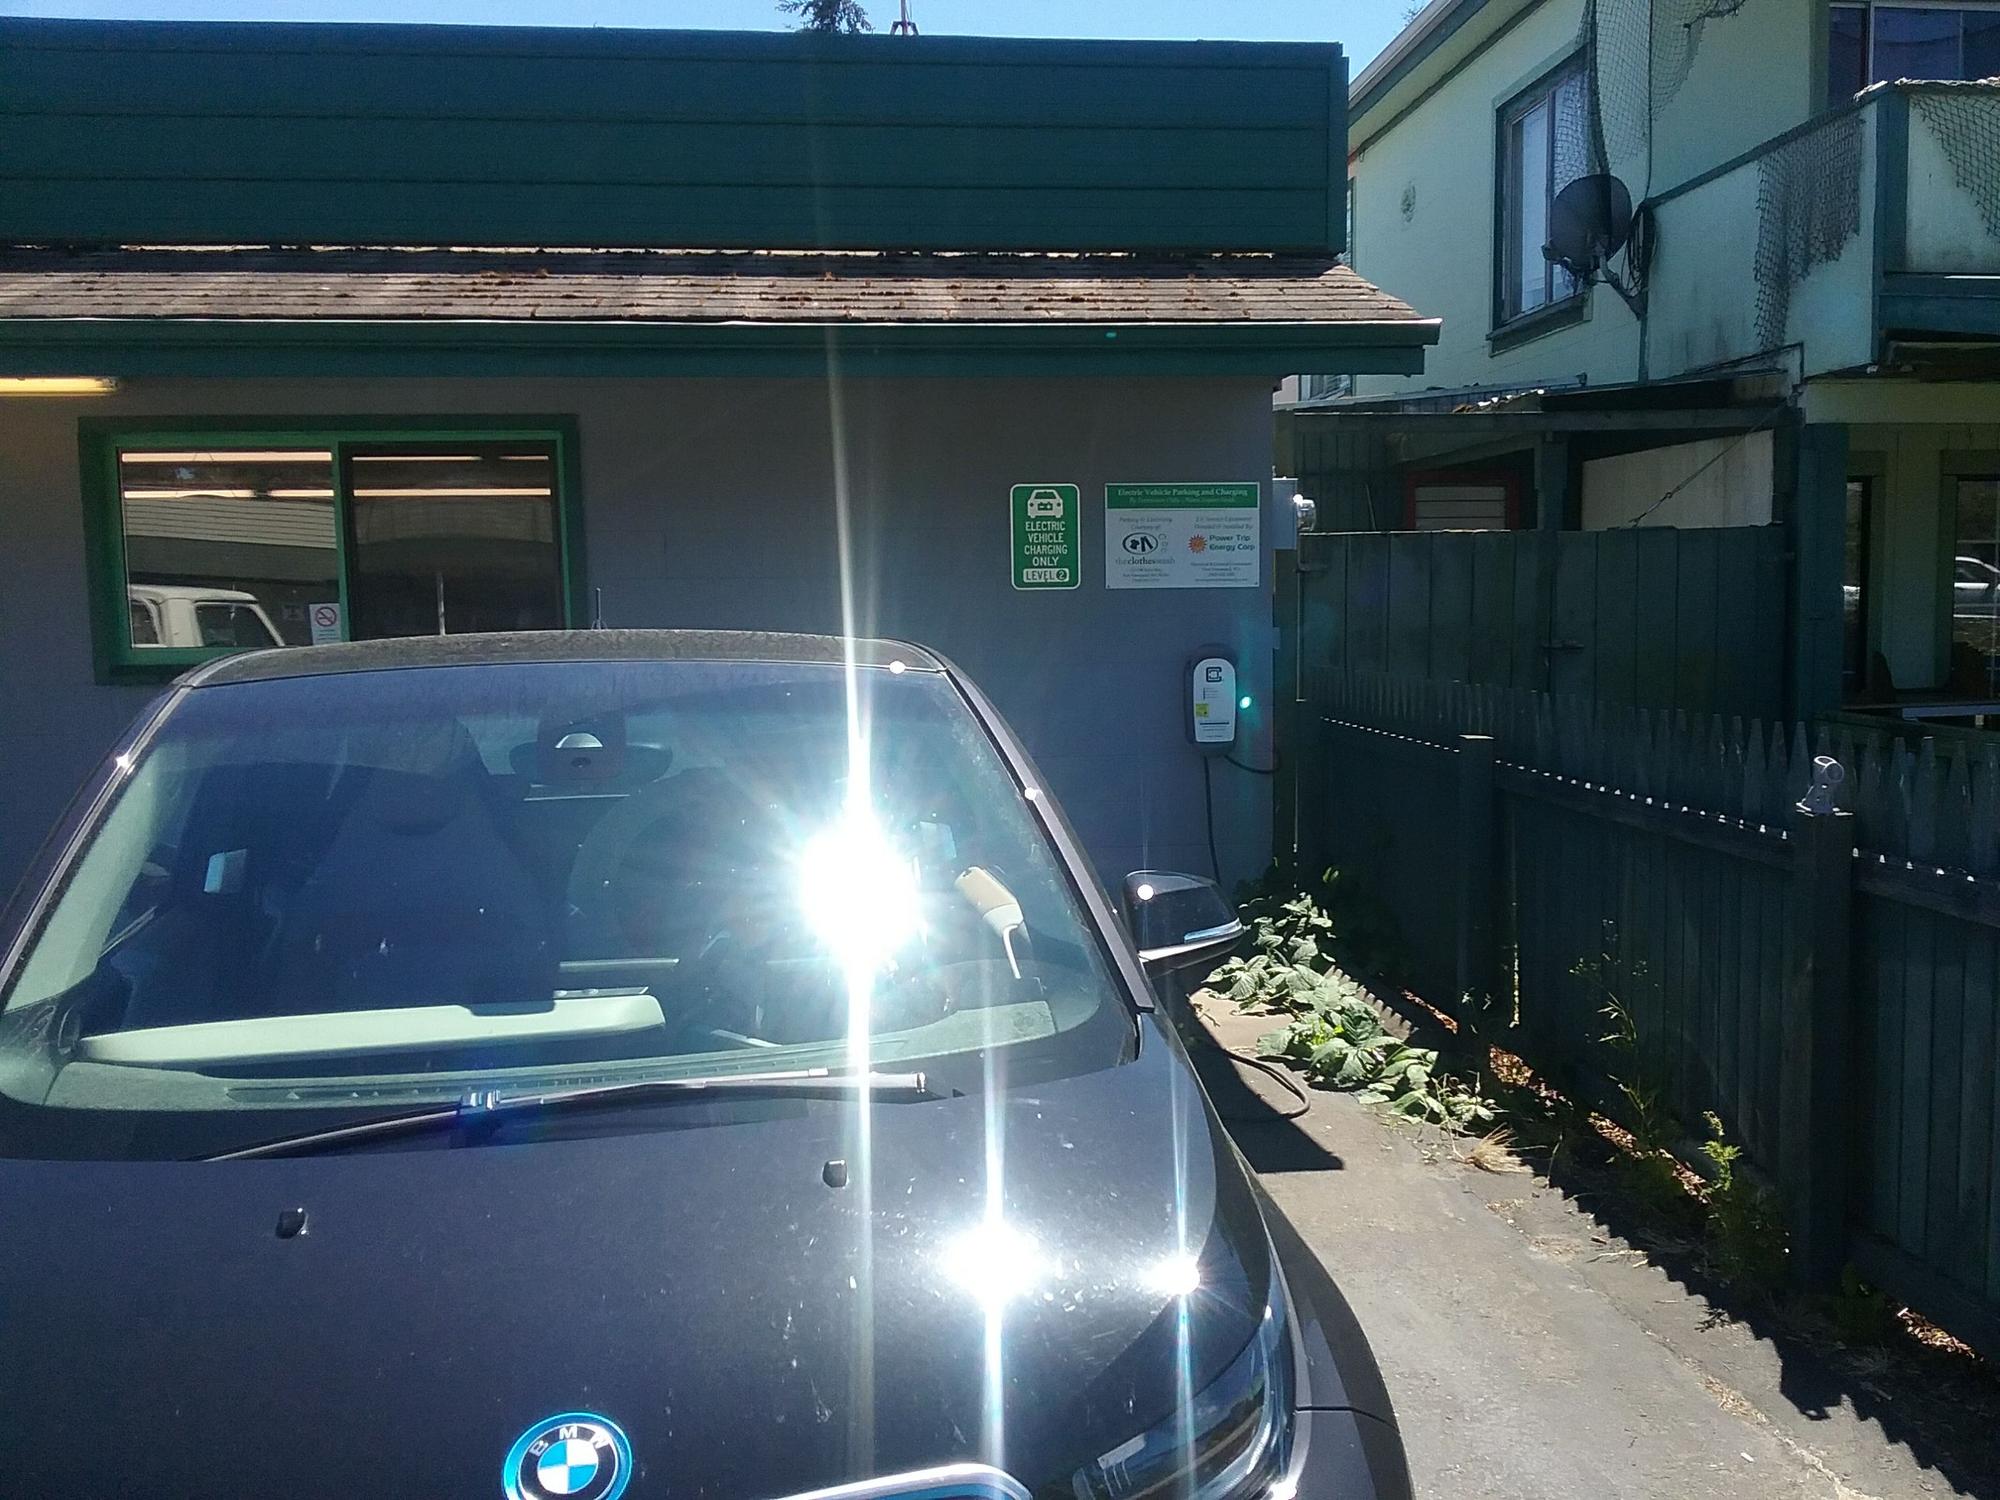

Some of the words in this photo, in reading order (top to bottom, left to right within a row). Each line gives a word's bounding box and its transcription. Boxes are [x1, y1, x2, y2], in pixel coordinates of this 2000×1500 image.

[1118, 488, 1144, 497] Electric
[1145, 488, 1171, 497] Vehicle
[1172, 488, 1201, 498] Parking
[1202, 488, 1214, 497] and
[1215, 488, 1248, 498] Charging
[1025, 521, 1066, 532] ELECTRIC
[1027, 532, 1064, 543] VEHICLE
[1236, 534, 1251, 542] Trip
[1024, 544, 1068, 555] CHARGING
[1209, 543, 1236, 551] Energy
[1237, 543, 1255, 551] Corp
[1032, 556, 1059, 567] ONLY
[1025, 570, 1056, 580] LEVEL
[529, 1425, 610, 1456] BMW
